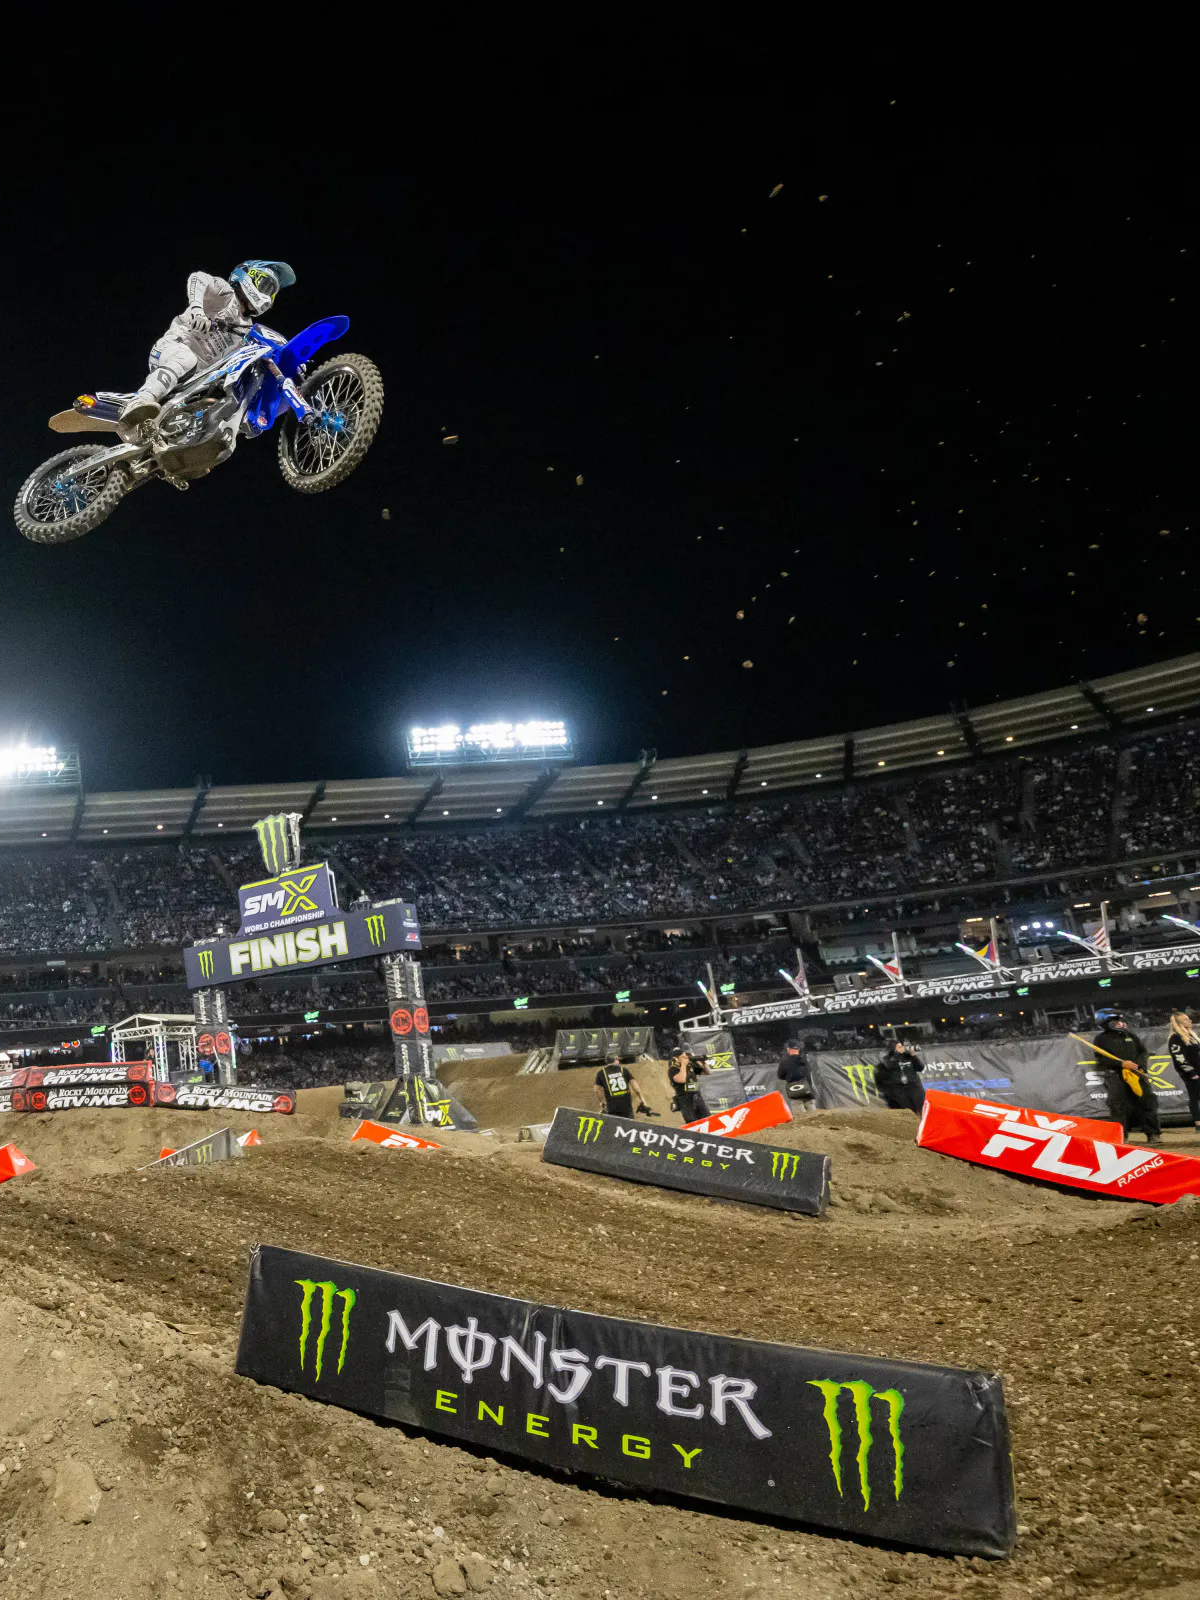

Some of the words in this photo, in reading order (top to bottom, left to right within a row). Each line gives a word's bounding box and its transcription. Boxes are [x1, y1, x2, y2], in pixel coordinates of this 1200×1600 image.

[243, 873, 318, 917] SMX
[244, 922, 269, 934] WORLD
[270, 910, 325, 928] CHAMPIONSHIP
[229, 920, 349, 976] FINISH
[1146, 951, 1171, 959] ROCKY
[1173, 947, 1200, 957] MOUN
[1032, 965, 1057, 974] ROCKY
[1059, 960, 1100, 971] MOUNTAIN
[928, 979, 952, 988] ROCKY
[953, 974, 993, 985] MOUNTAIN
[858, 988, 897, 999] MOUNTAIN
[960, 990, 1010, 1001] LEXUS
[742, 1008, 763, 1016] ROCKY
[764, 1003, 801, 1013] MOUNTAIN
[83, 1066, 129, 1074] MOUNTAIN
[922, 1061, 974, 1073] NSTER
[59, 1089, 83, 1097] ROCKY
[84, 1087, 129, 1096] MOUNTAIN
[609, 1077, 627, 1092] 26
[192, 1086, 222, 1097] ROCKY
[222, 1088, 273, 1101] MOUNTAIN
[613, 1125, 755, 1164] MONSTER
[632, 1147, 731, 1170] ENERGY
[981, 1121, 1159, 1185] FLY
[1117, 1156, 1164, 1188] RACING
[385, 1309, 773, 1441] MONSTER
[435, 1389, 703, 1470] ENERGY
